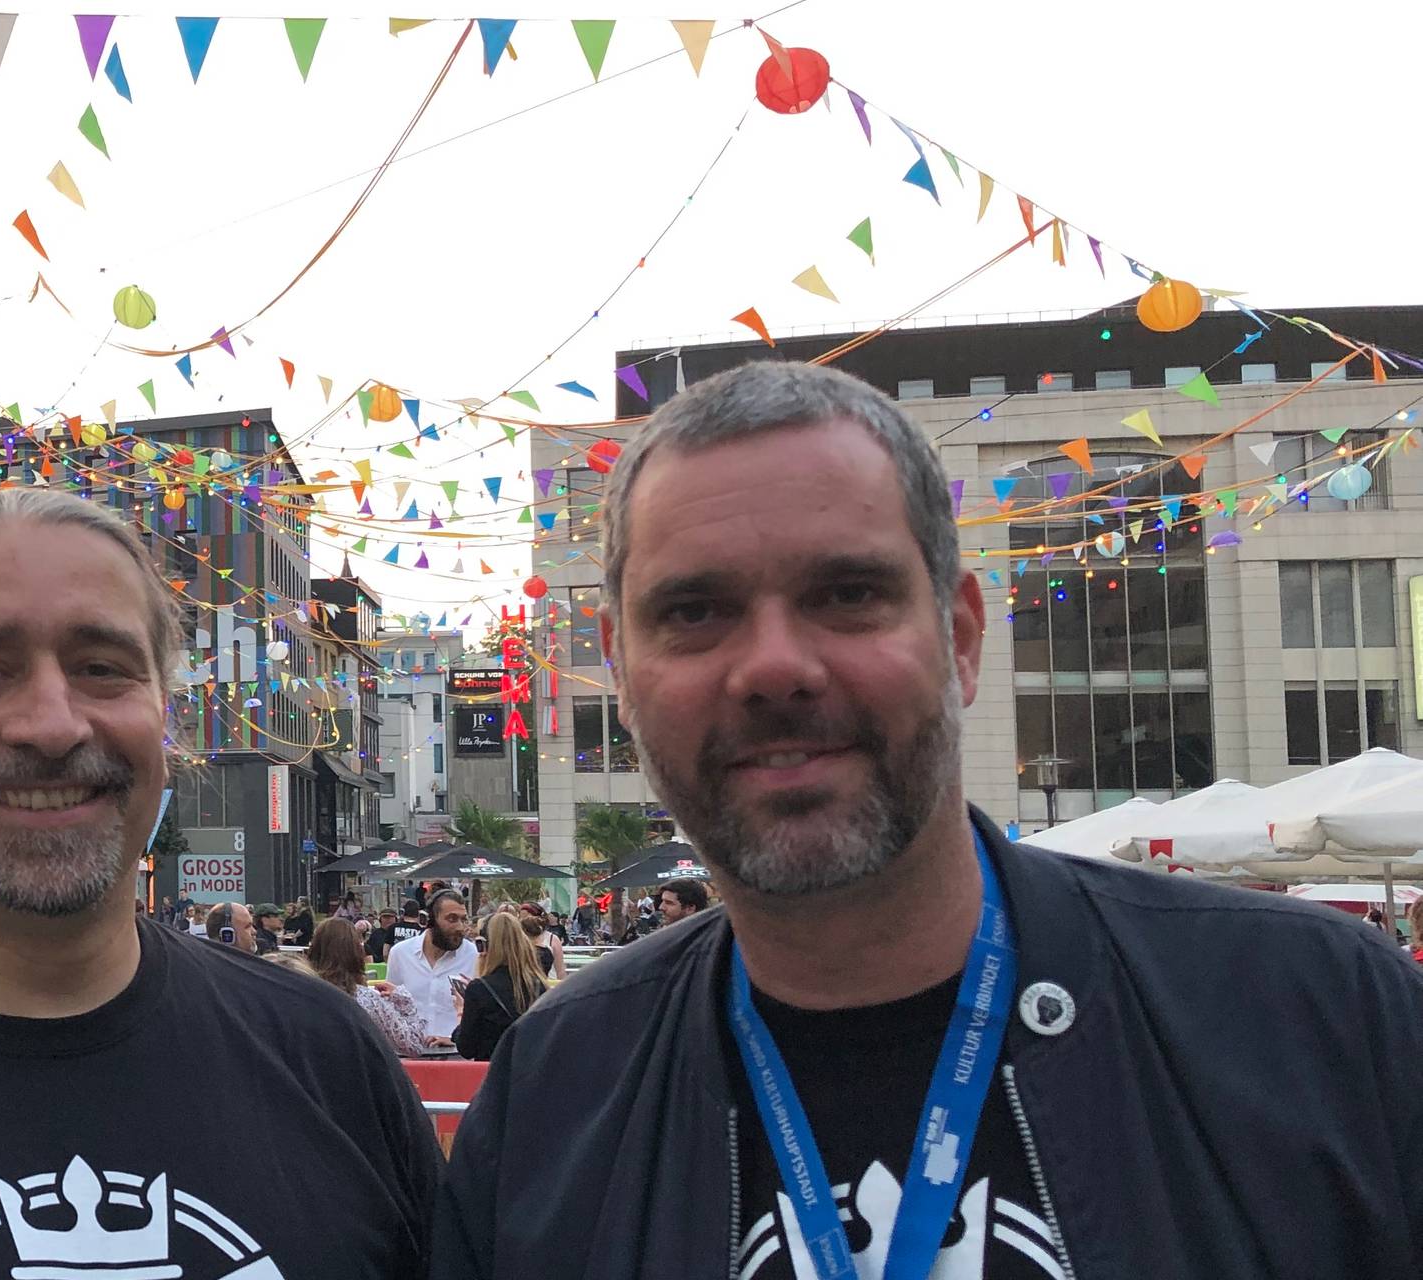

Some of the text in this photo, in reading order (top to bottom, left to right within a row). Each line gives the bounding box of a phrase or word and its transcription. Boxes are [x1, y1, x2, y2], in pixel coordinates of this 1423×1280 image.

[500, 604, 530, 740] HEMA
[472, 713, 486, 728] JP
[234, 831, 245, 851] 8
[182, 859, 243, 876] GROSS
[183, 878, 244, 892] in MODE
[394, 926, 421, 937] NASTY
[953, 955, 1002, 1085] KULTUR VERBINDET
